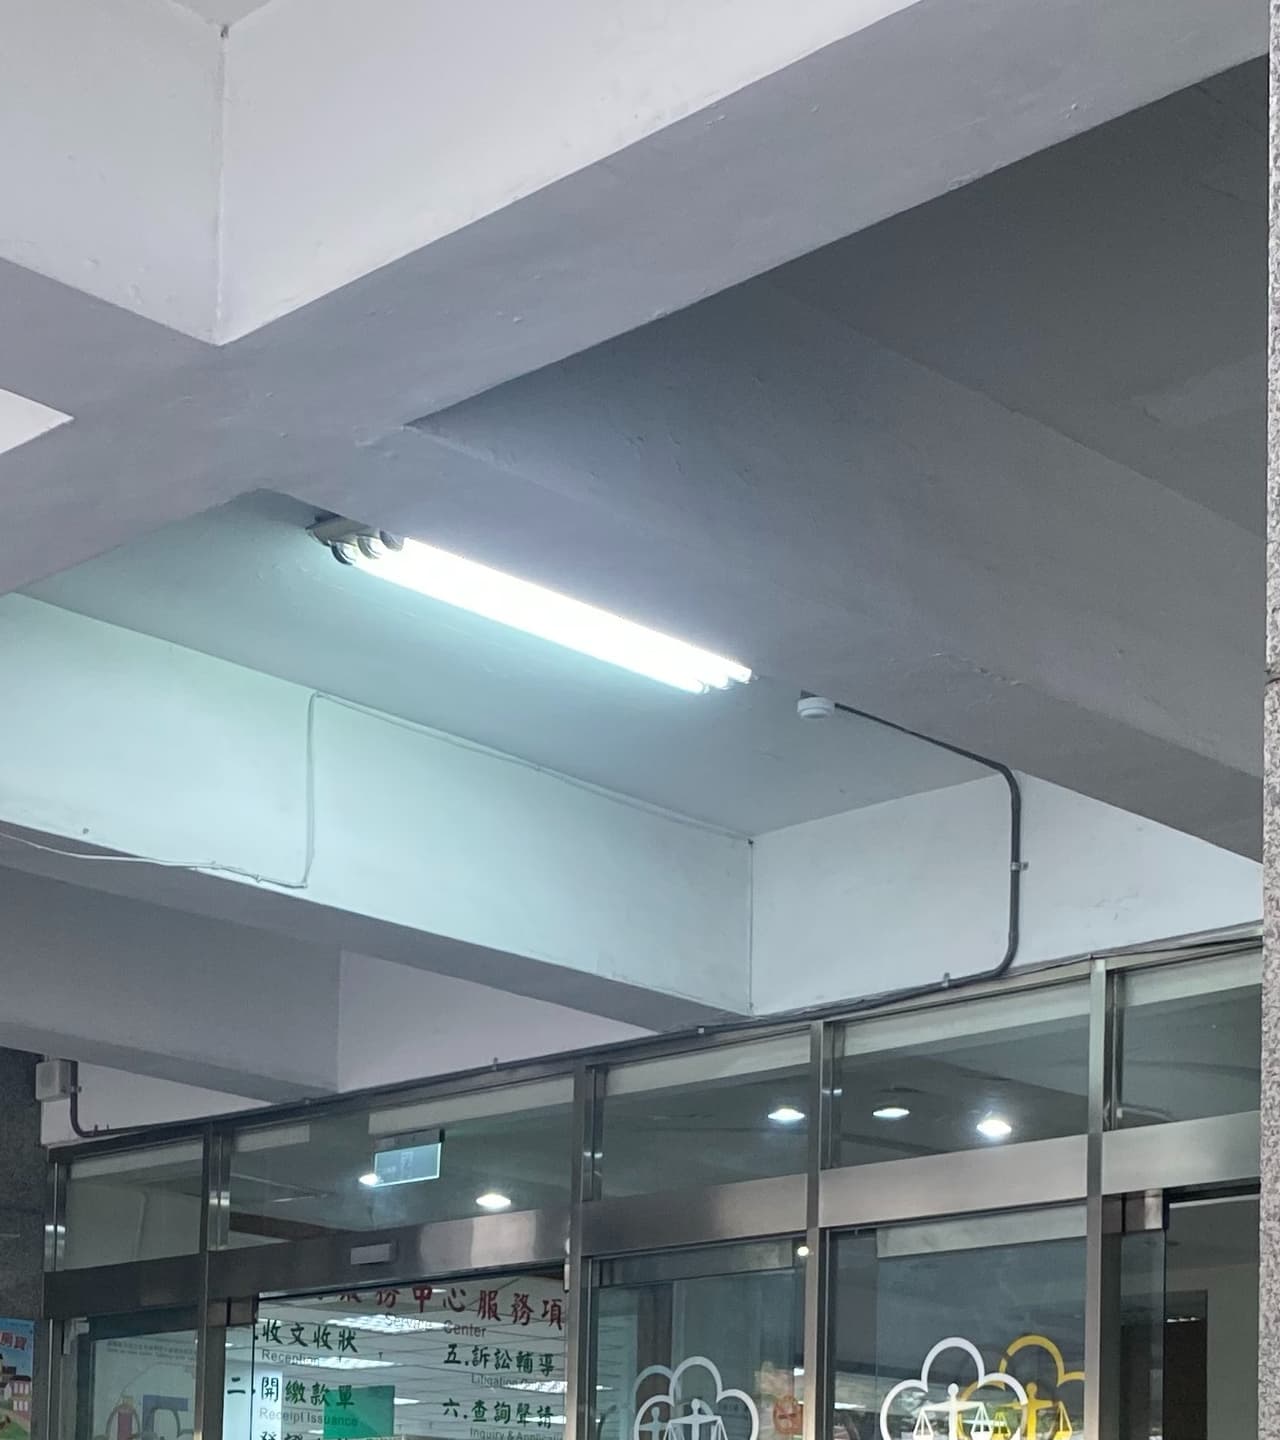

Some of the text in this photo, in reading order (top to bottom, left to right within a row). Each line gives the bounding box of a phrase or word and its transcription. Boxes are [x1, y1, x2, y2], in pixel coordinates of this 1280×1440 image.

[443, 1320, 487, 1338] Center
[258, 1407, 359, 1428] Receipt Issuance
